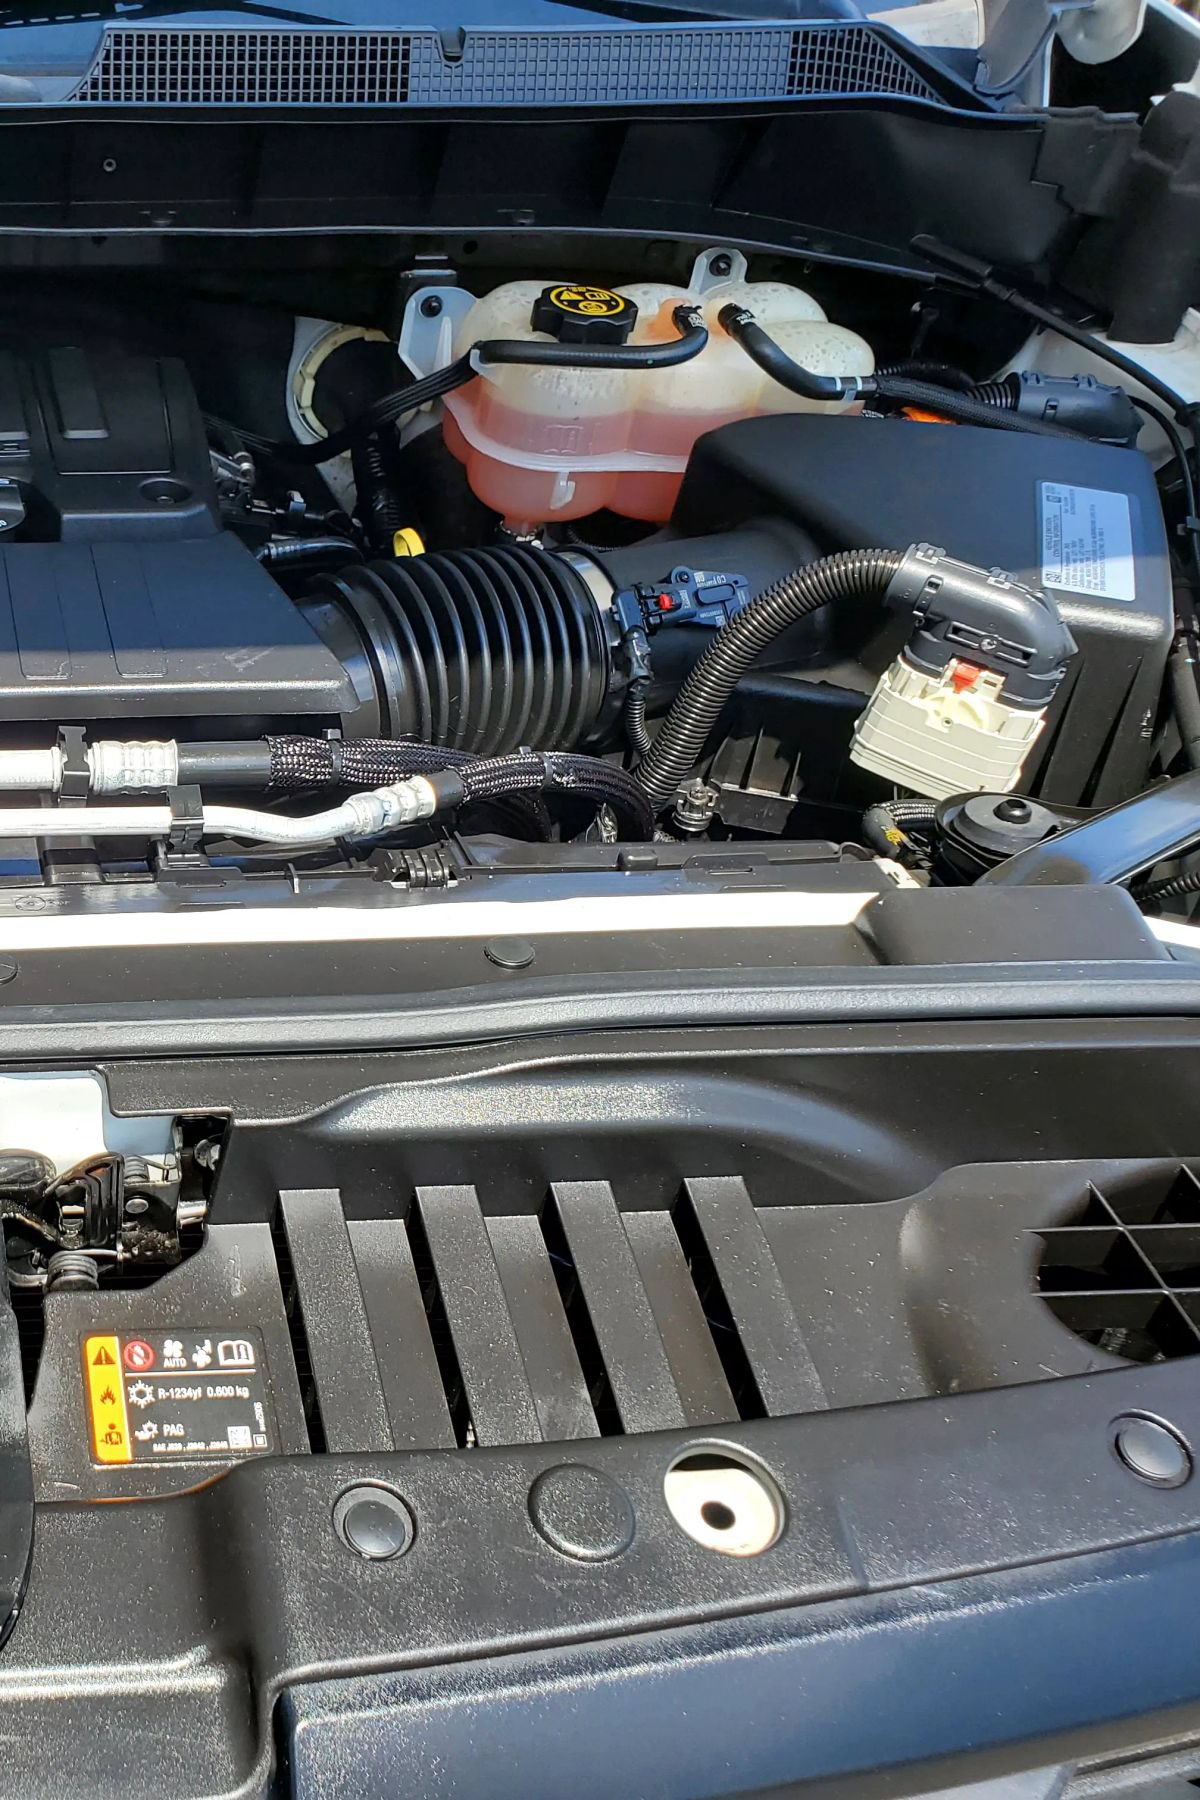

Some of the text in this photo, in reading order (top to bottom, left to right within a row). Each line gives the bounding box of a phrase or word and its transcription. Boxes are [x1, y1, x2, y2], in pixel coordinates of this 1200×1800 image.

[163, 1358, 187, 1368] AUTO
[235, 1385, 250, 1398] kg
[163, 1424, 185, 1437] PAG
